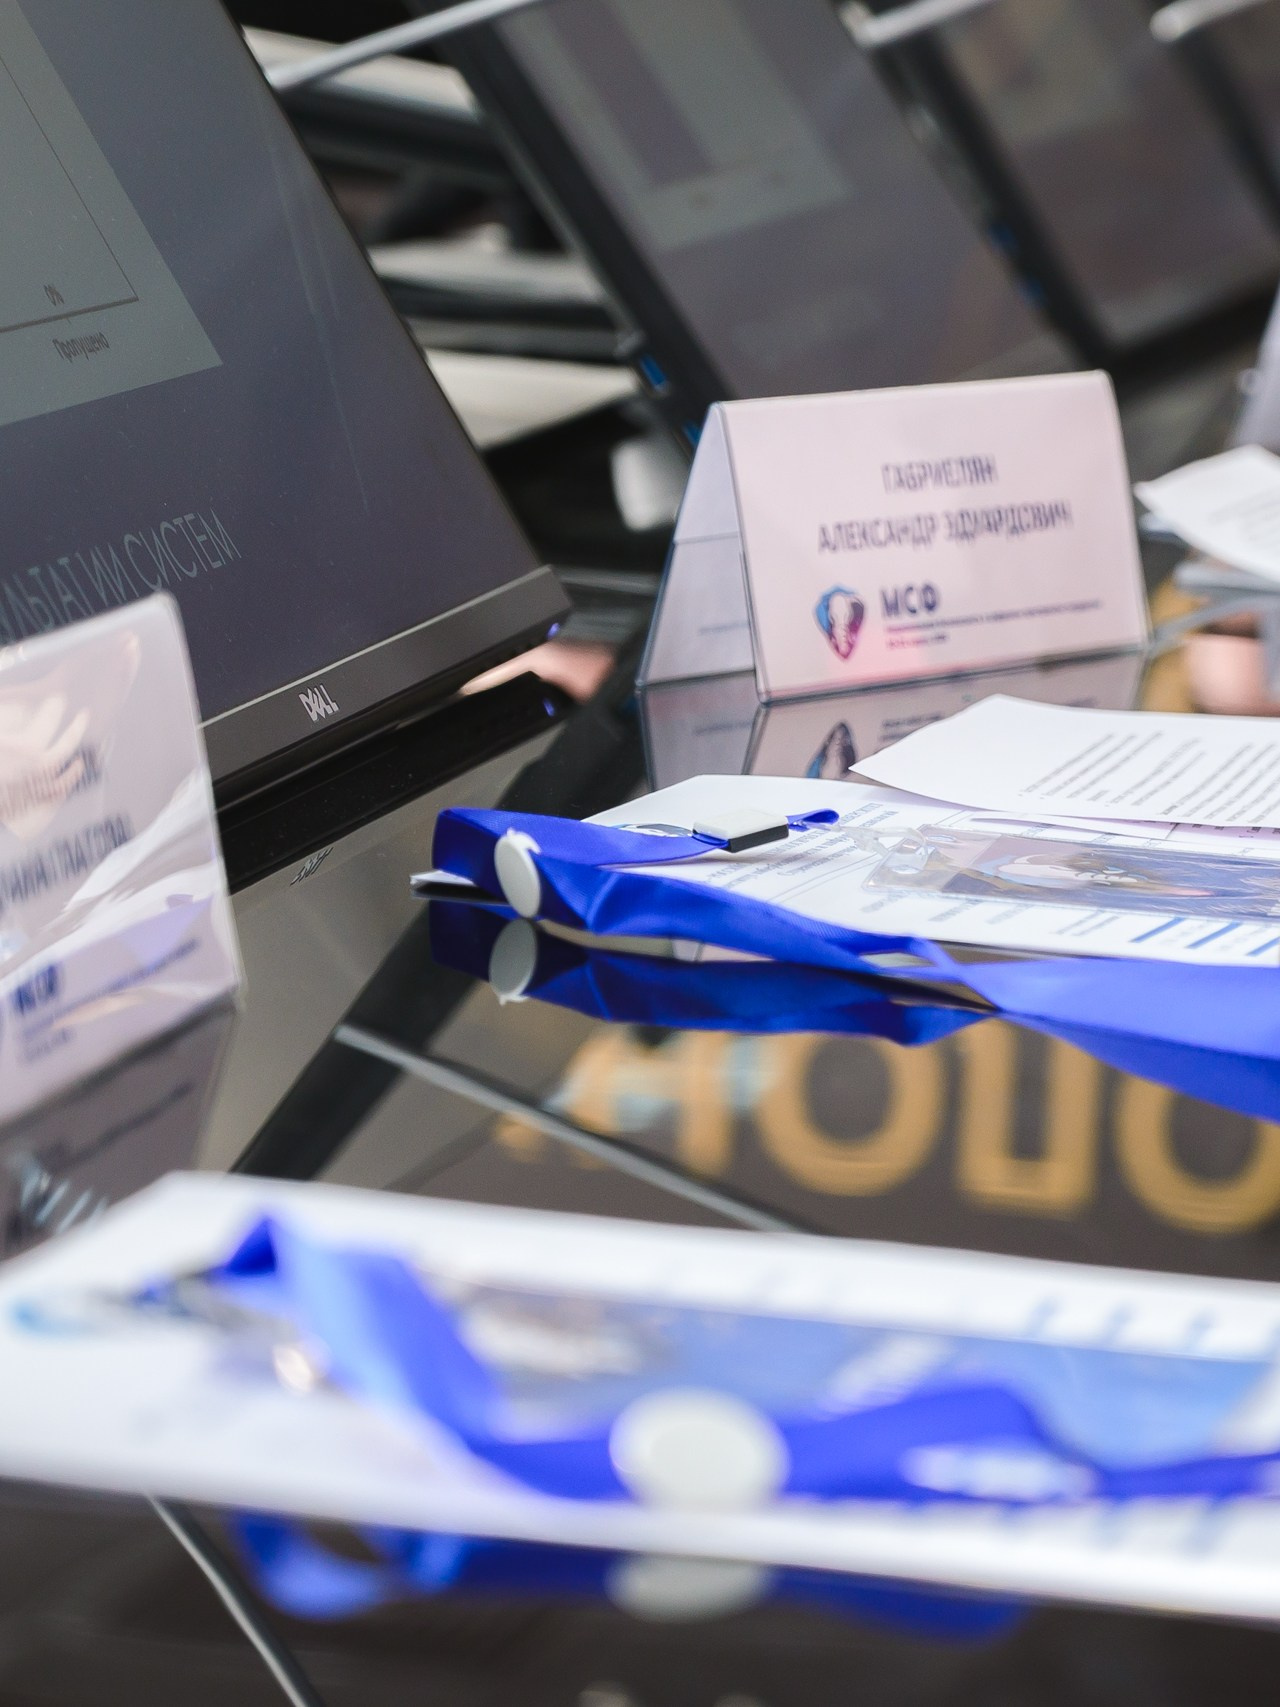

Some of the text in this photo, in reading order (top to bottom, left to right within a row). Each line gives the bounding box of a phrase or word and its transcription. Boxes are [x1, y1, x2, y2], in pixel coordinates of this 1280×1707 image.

[124, 508, 242, 592] СИСТЕМ
[817, 514, 940, 554] АЛЕКСАНДР
[299, 685, 340, 721] DELL
